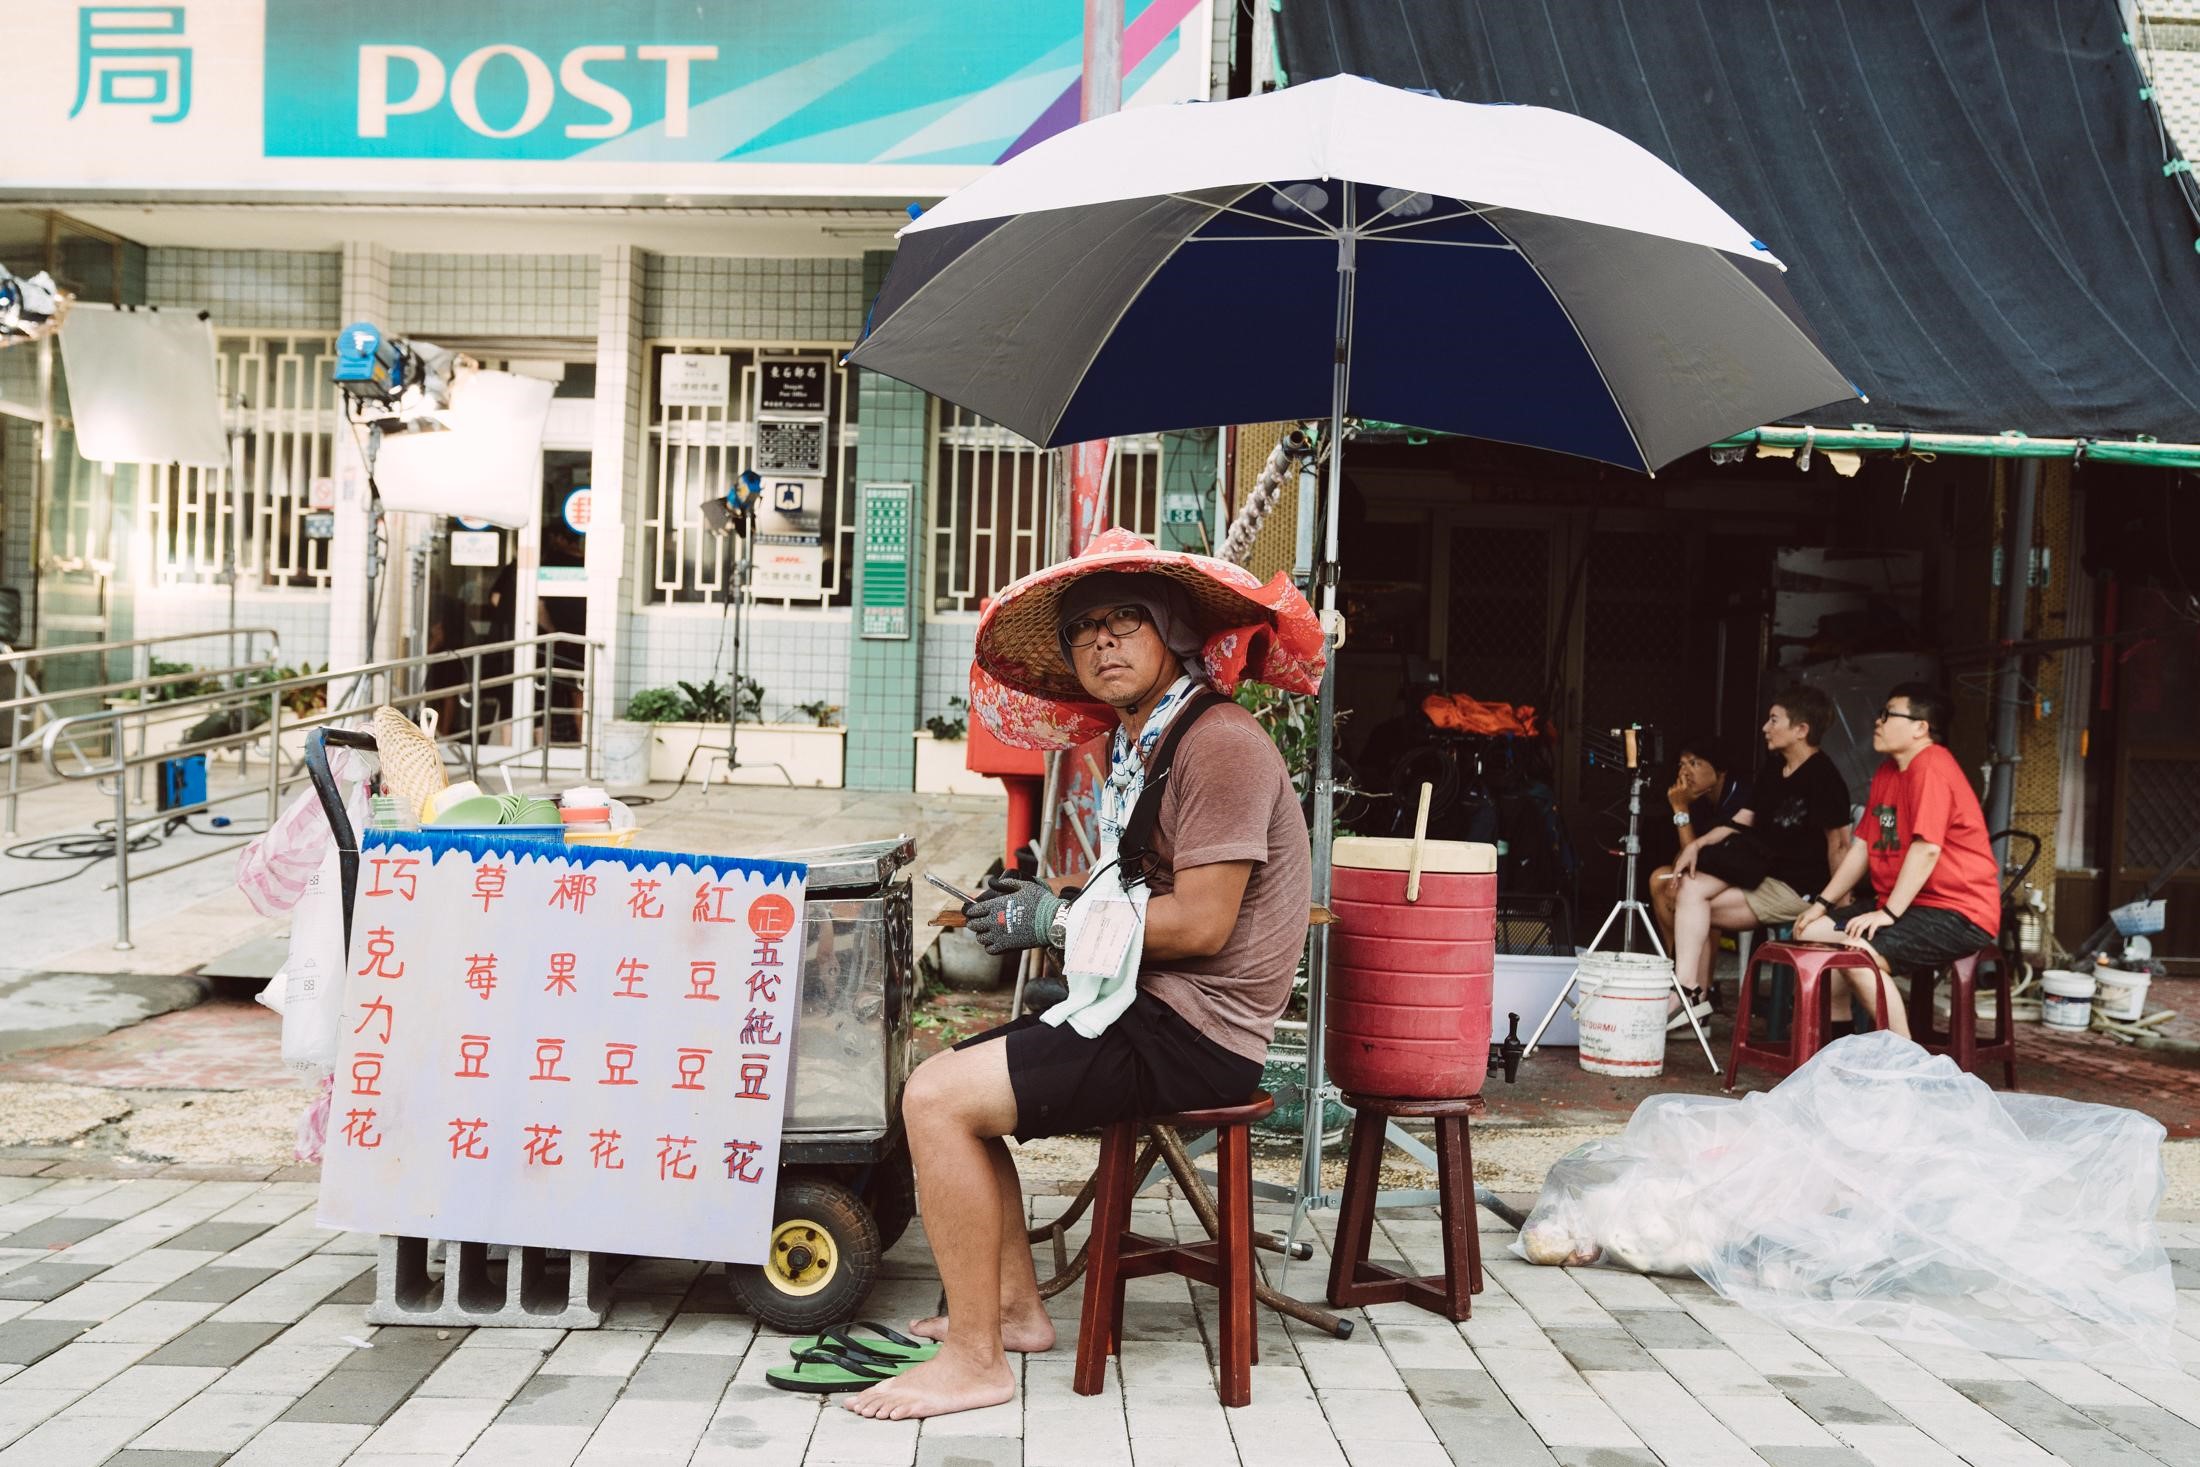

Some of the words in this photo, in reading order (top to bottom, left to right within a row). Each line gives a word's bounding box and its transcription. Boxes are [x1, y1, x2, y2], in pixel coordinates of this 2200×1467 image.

[70, 7, 193, 123] 局
[357, 44, 719, 139] POST
[341, 858, 420, 1149] 巧克力豆花
[448, 863, 507, 1160] 草莓豆花
[523, 873, 598, 1167] 椰果豆花
[589, 878, 665, 1170] 花生豆花
[656, 881, 736, 1182] 紅豆豆花
